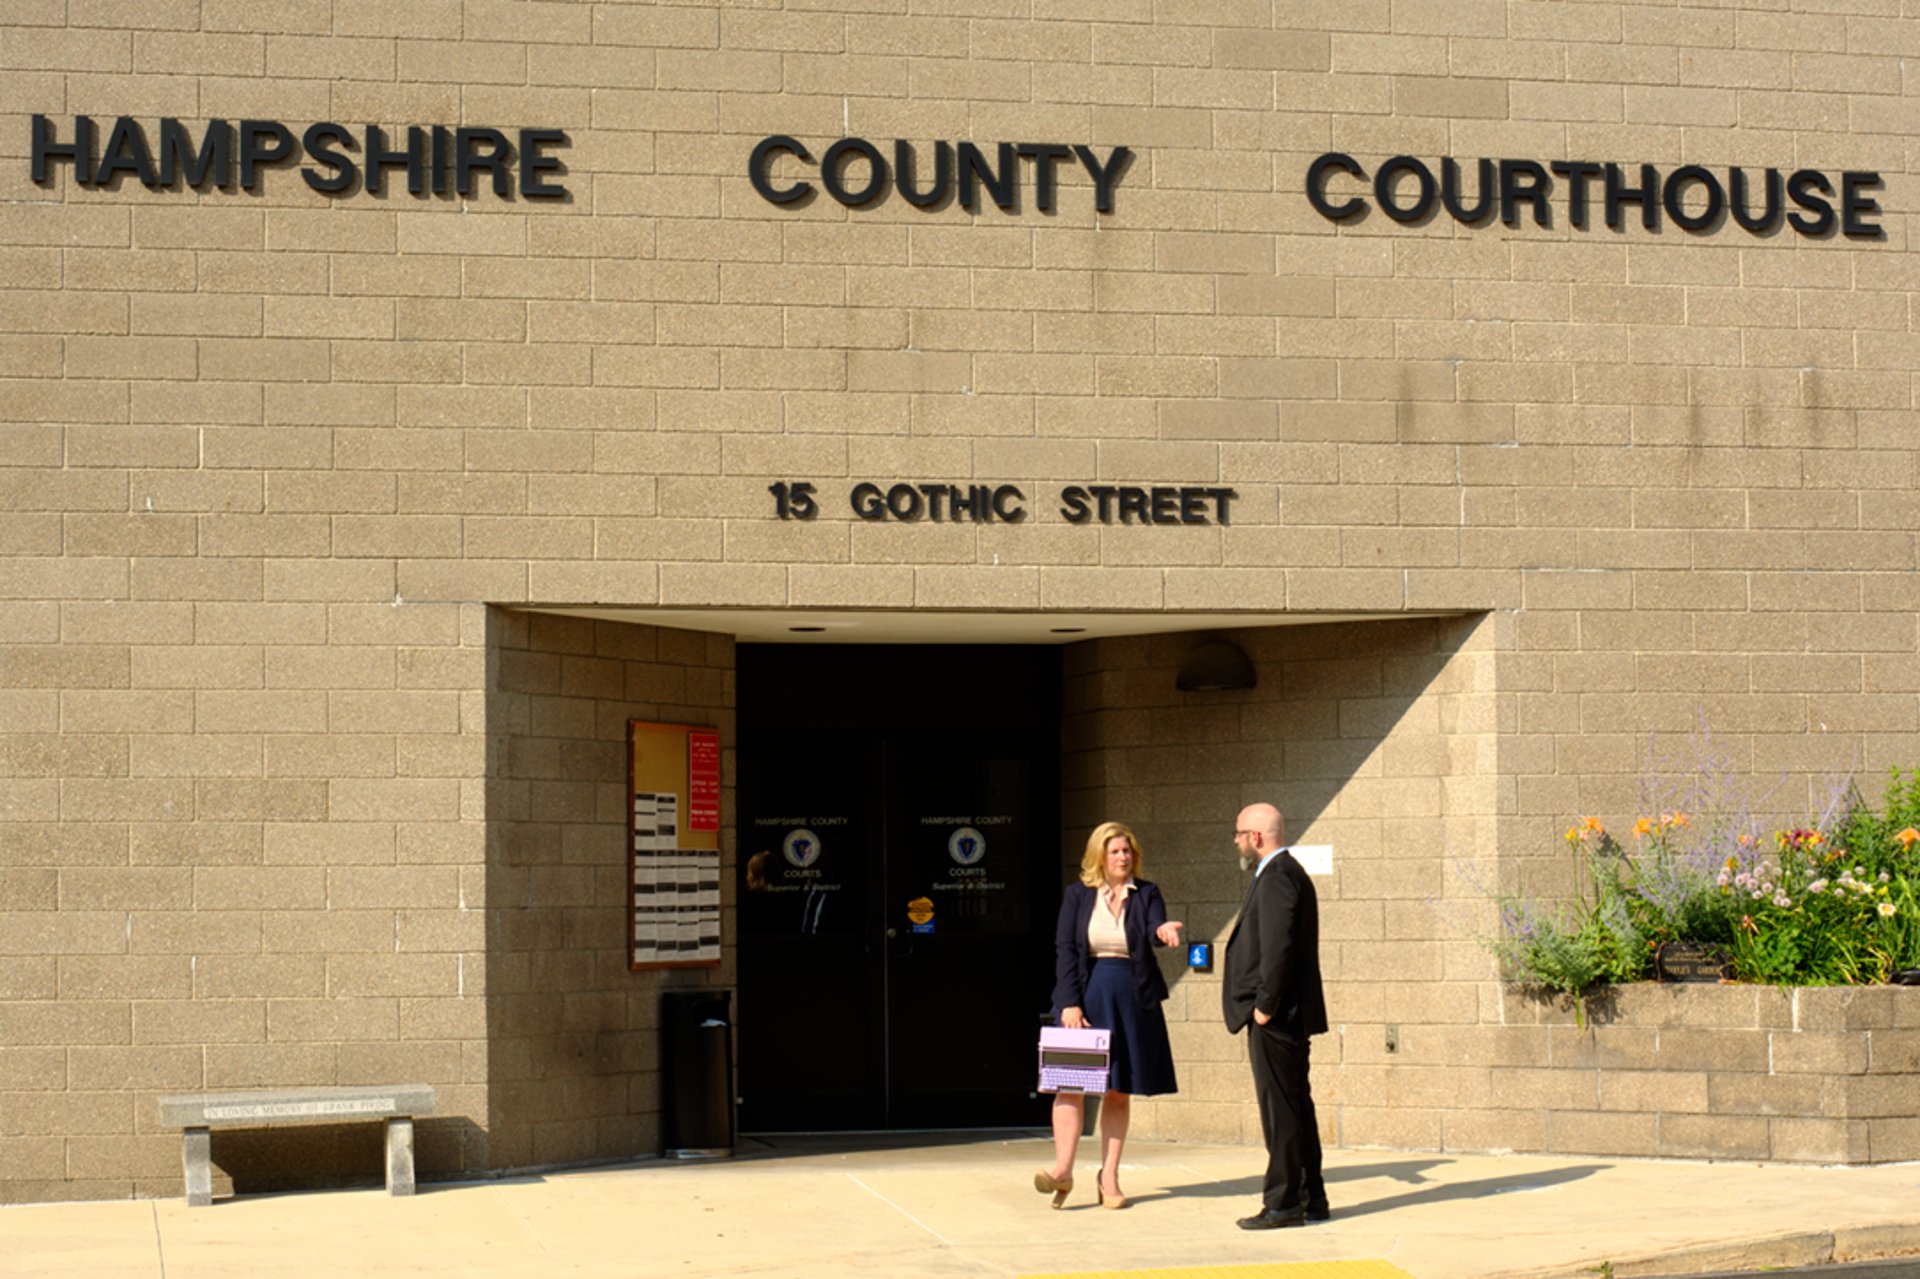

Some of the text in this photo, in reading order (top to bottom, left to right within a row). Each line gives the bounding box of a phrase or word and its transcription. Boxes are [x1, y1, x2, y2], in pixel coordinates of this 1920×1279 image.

[30, 114, 1883, 236] HAMPSHIRE COUNTY COURTHOUSE
[768, 481, 1234, 525] 15 GOTHIC STREET
[755, 816, 849, 826] HAMPSHIRE COUNTY
[920, 816, 1013, 825] HAMPSHIRE COUNTY
[784, 869, 822, 878] COURTS
[948, 868, 986, 877] COURTS
[767, 883, 801, 892] Superior
[932, 882, 965, 890] Superior
